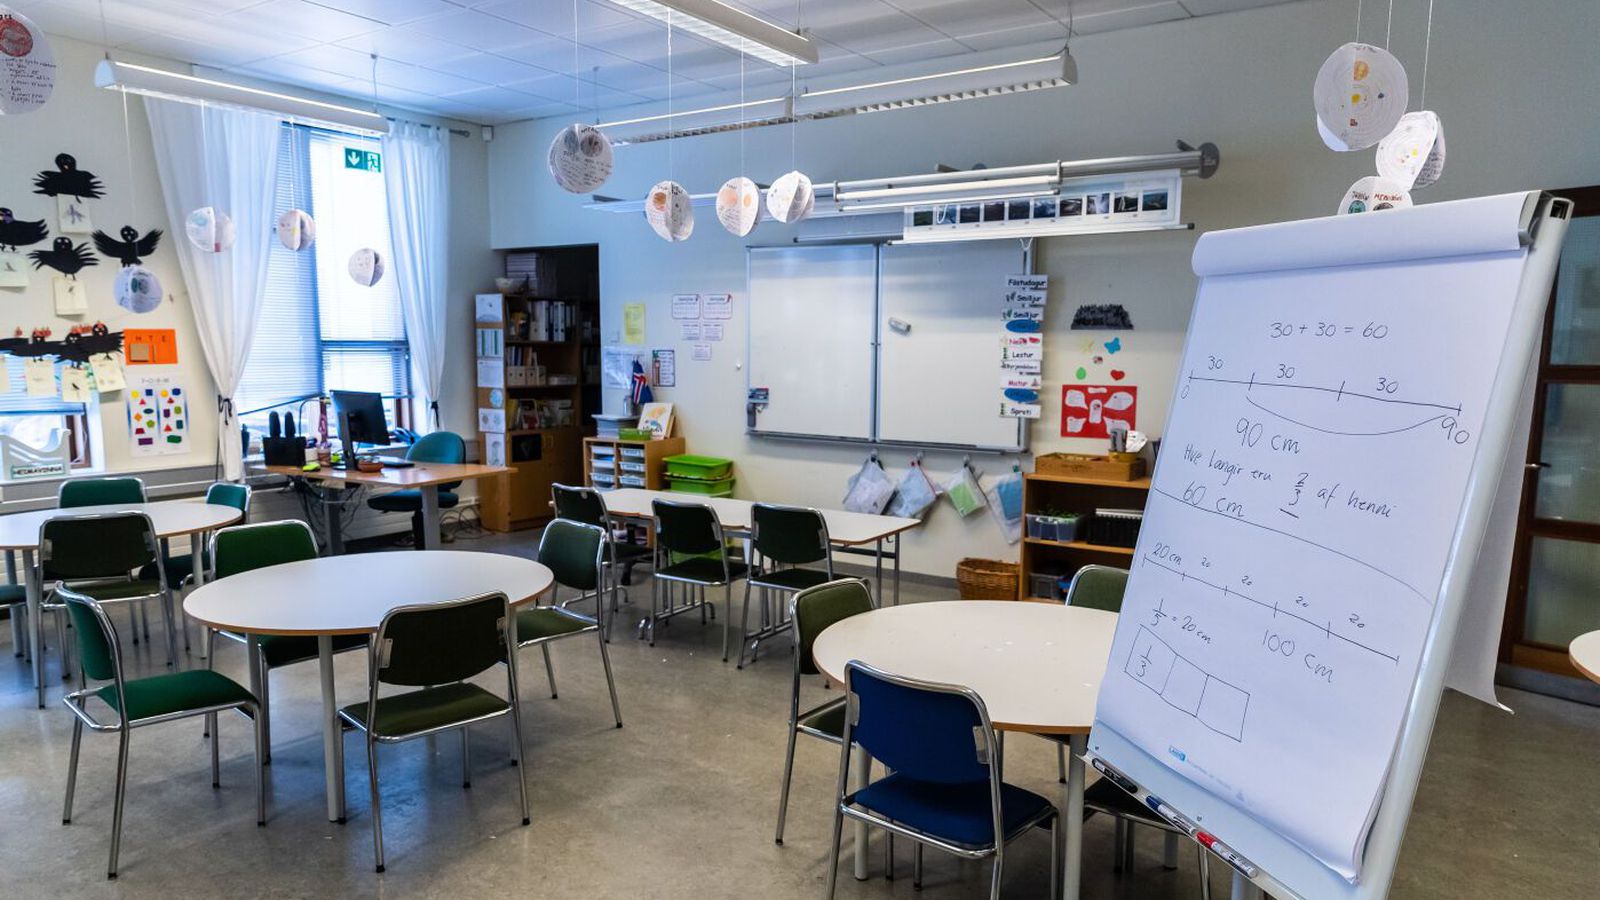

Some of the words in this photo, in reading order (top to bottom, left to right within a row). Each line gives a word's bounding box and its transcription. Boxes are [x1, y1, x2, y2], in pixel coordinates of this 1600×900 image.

[1270, 322, 1293, 338] 30
[1314, 322, 1337, 338] 30
[1362, 321, 1388, 339] 60
[1012, 351, 1034, 359] Lestur
[1207, 355, 1224, 370] 30
[1277, 363, 1295, 379] 30
[1376, 377, 1399, 394] 30
[1236, 417, 1263, 448] 90
[1270, 434, 1300, 453] cm
[1440, 416, 1470, 445] 90
[1182, 480, 1206, 506] 60
[1215, 496, 1245, 518] cm
[1262, 630, 1295, 657] 100
[1304, 653, 1335, 683] cm
